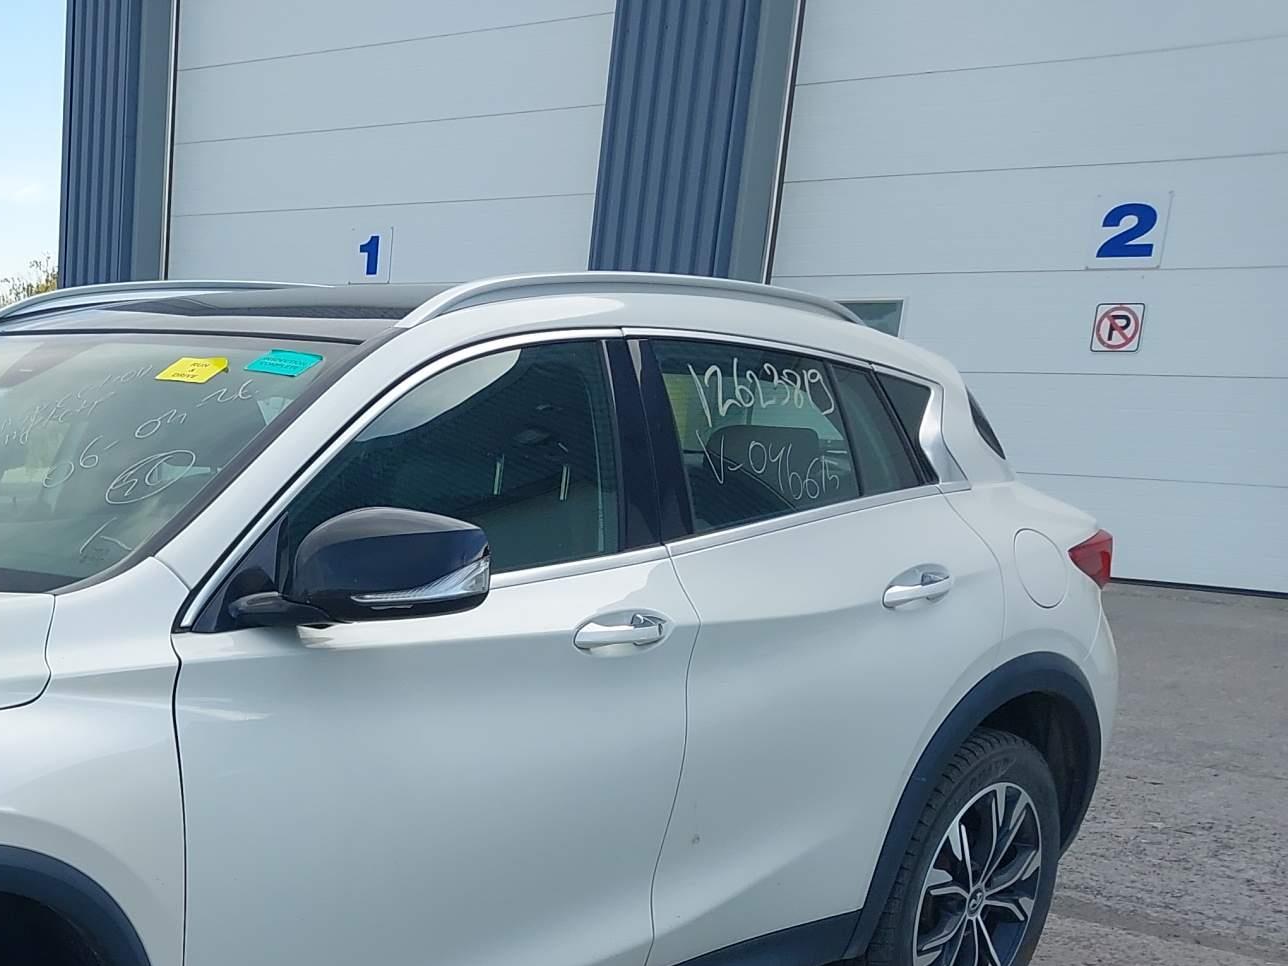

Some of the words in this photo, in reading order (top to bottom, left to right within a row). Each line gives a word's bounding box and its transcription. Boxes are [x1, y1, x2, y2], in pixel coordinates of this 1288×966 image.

[359, 235, 380, 275] 1
[1096, 203, 1157, 258] 2
[687, 357, 835, 428] 12623819
